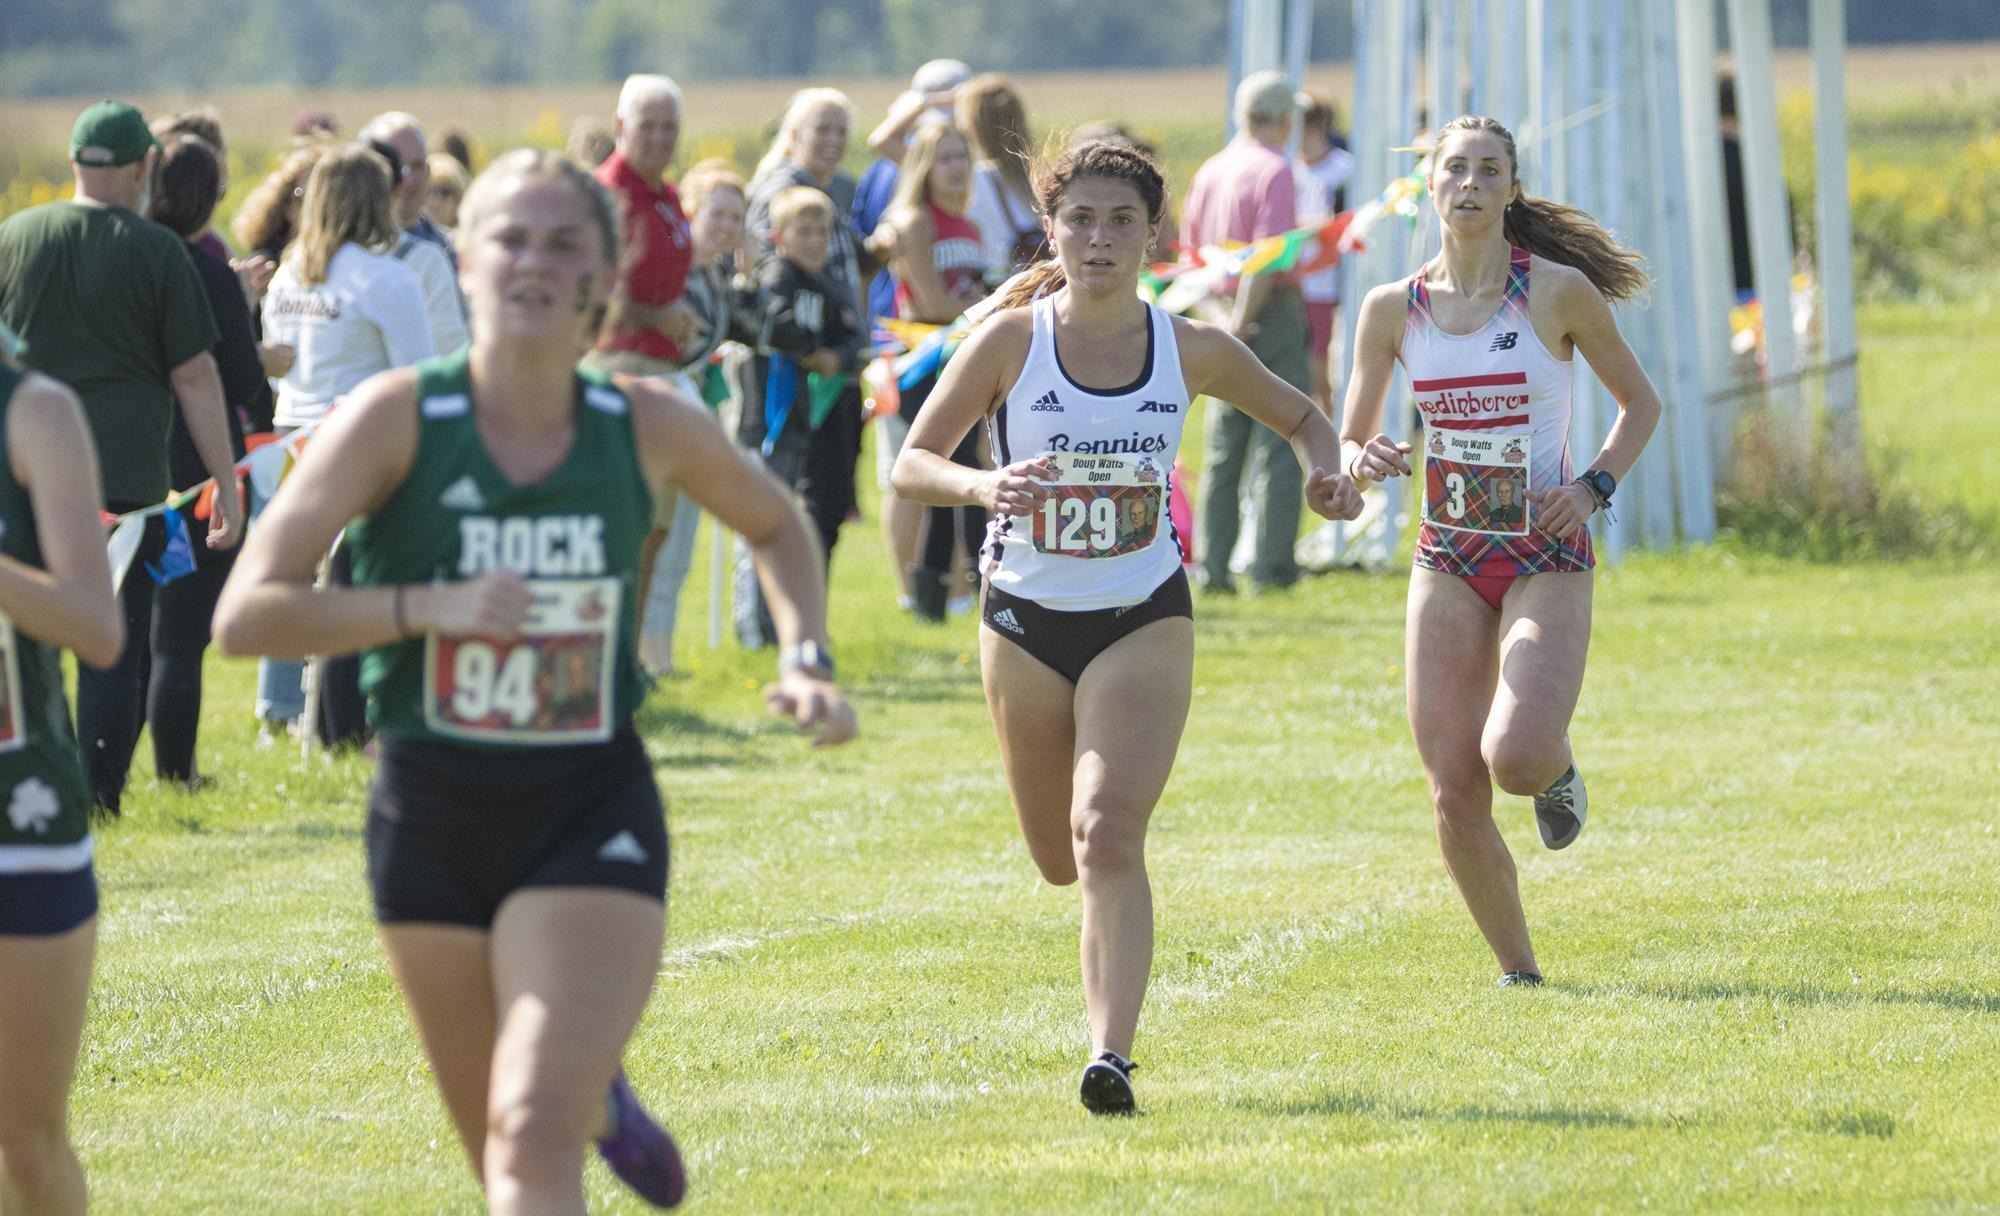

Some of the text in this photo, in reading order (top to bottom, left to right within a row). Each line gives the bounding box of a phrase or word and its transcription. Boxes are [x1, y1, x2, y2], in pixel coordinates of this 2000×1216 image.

[1030, 403, 1065, 413] adidas
[1136, 400, 1178, 413] A10
[1423, 391, 1520, 417] edinboro
[1048, 431, 1169, 455] Bonnies
[1451, 437, 1468, 450] Doug
[1470, 439, 1492, 450] Watts
[1072, 458, 1124, 469] Doug Watts
[1462, 450, 1481, 461] Open
[1088, 471, 1111, 482] Open
[1446, 472, 1465, 519] 3
[1039, 497, 1116, 550] 129
[458, 514, 606, 575] ROCK
[993, 613, 1025, 635] adidas
[453, 641, 538, 728] 94
